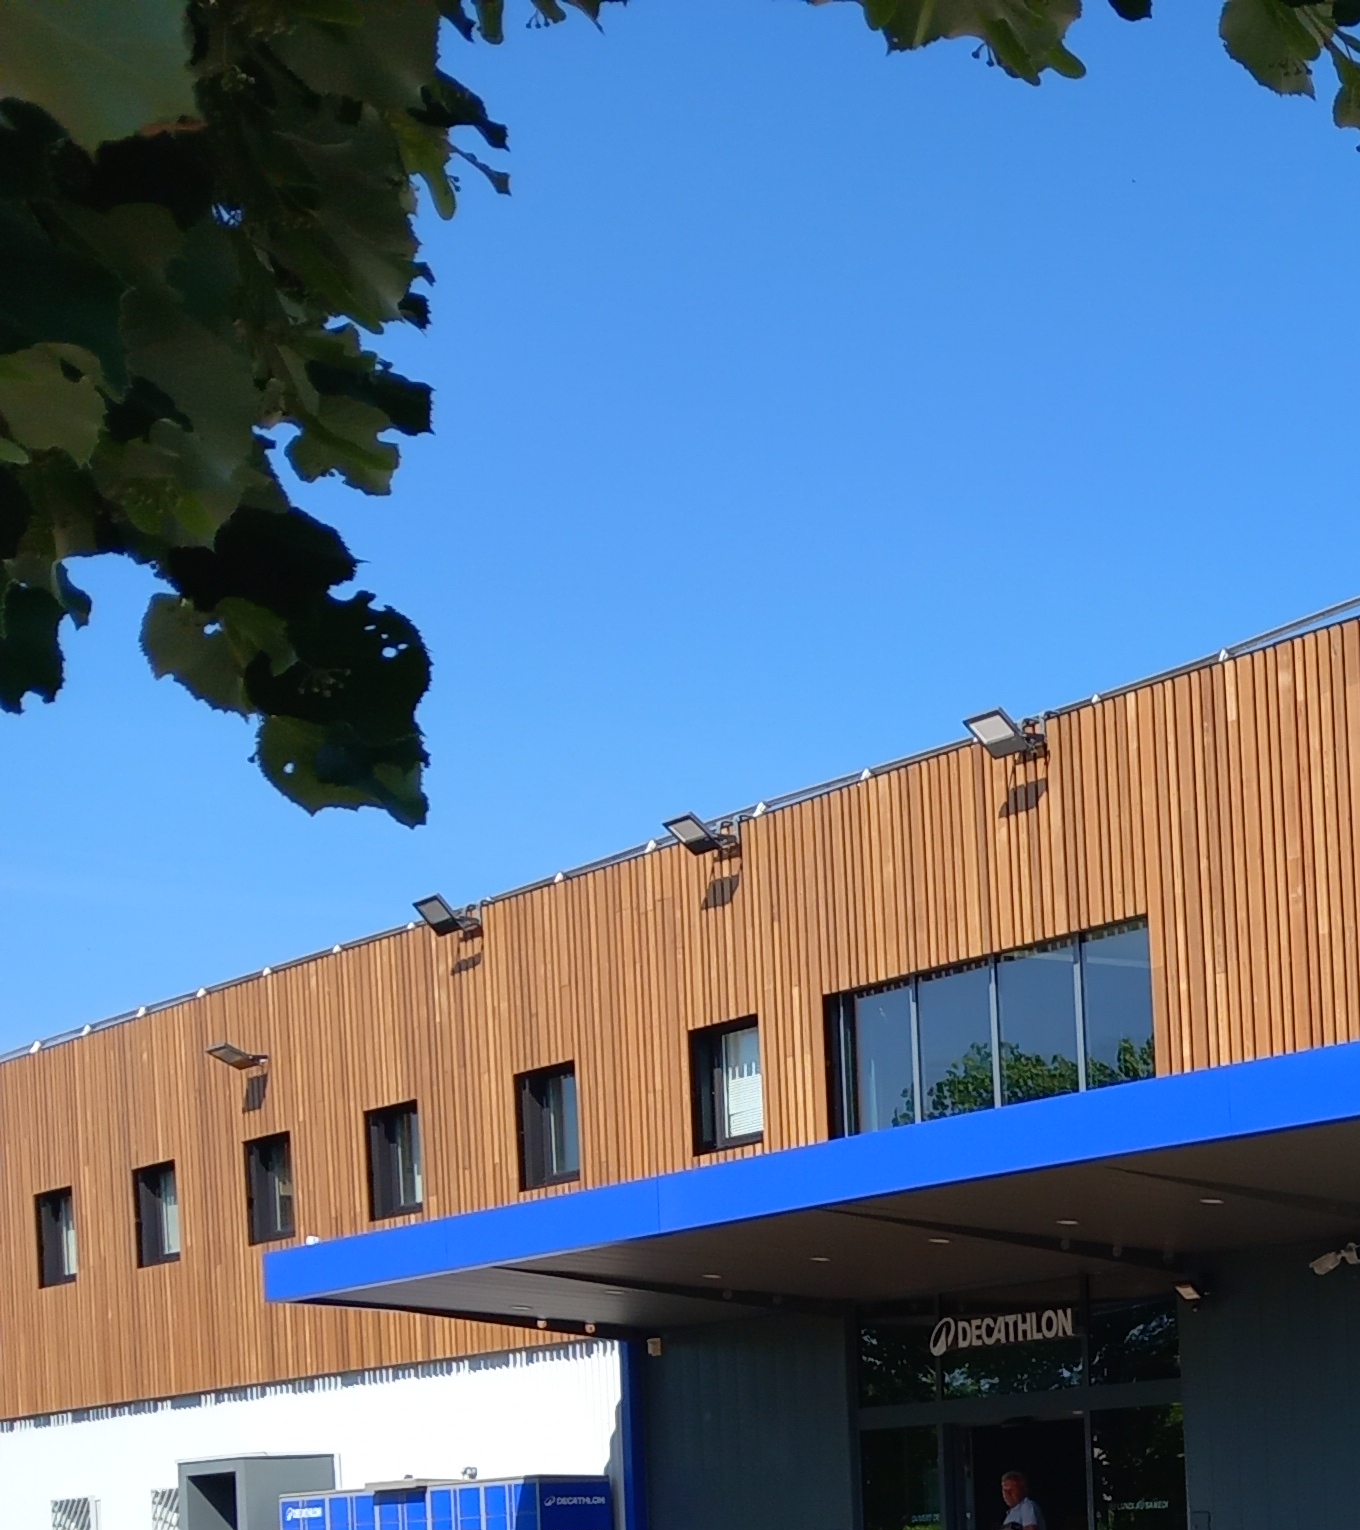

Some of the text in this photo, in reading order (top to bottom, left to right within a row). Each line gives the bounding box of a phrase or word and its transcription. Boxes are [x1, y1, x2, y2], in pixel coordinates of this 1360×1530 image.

[957, 1308, 1074, 1348] DECATHLON
[556, 1496, 606, 1505] DECATHLON
[292, 1507, 322, 1518] DECATHLON
